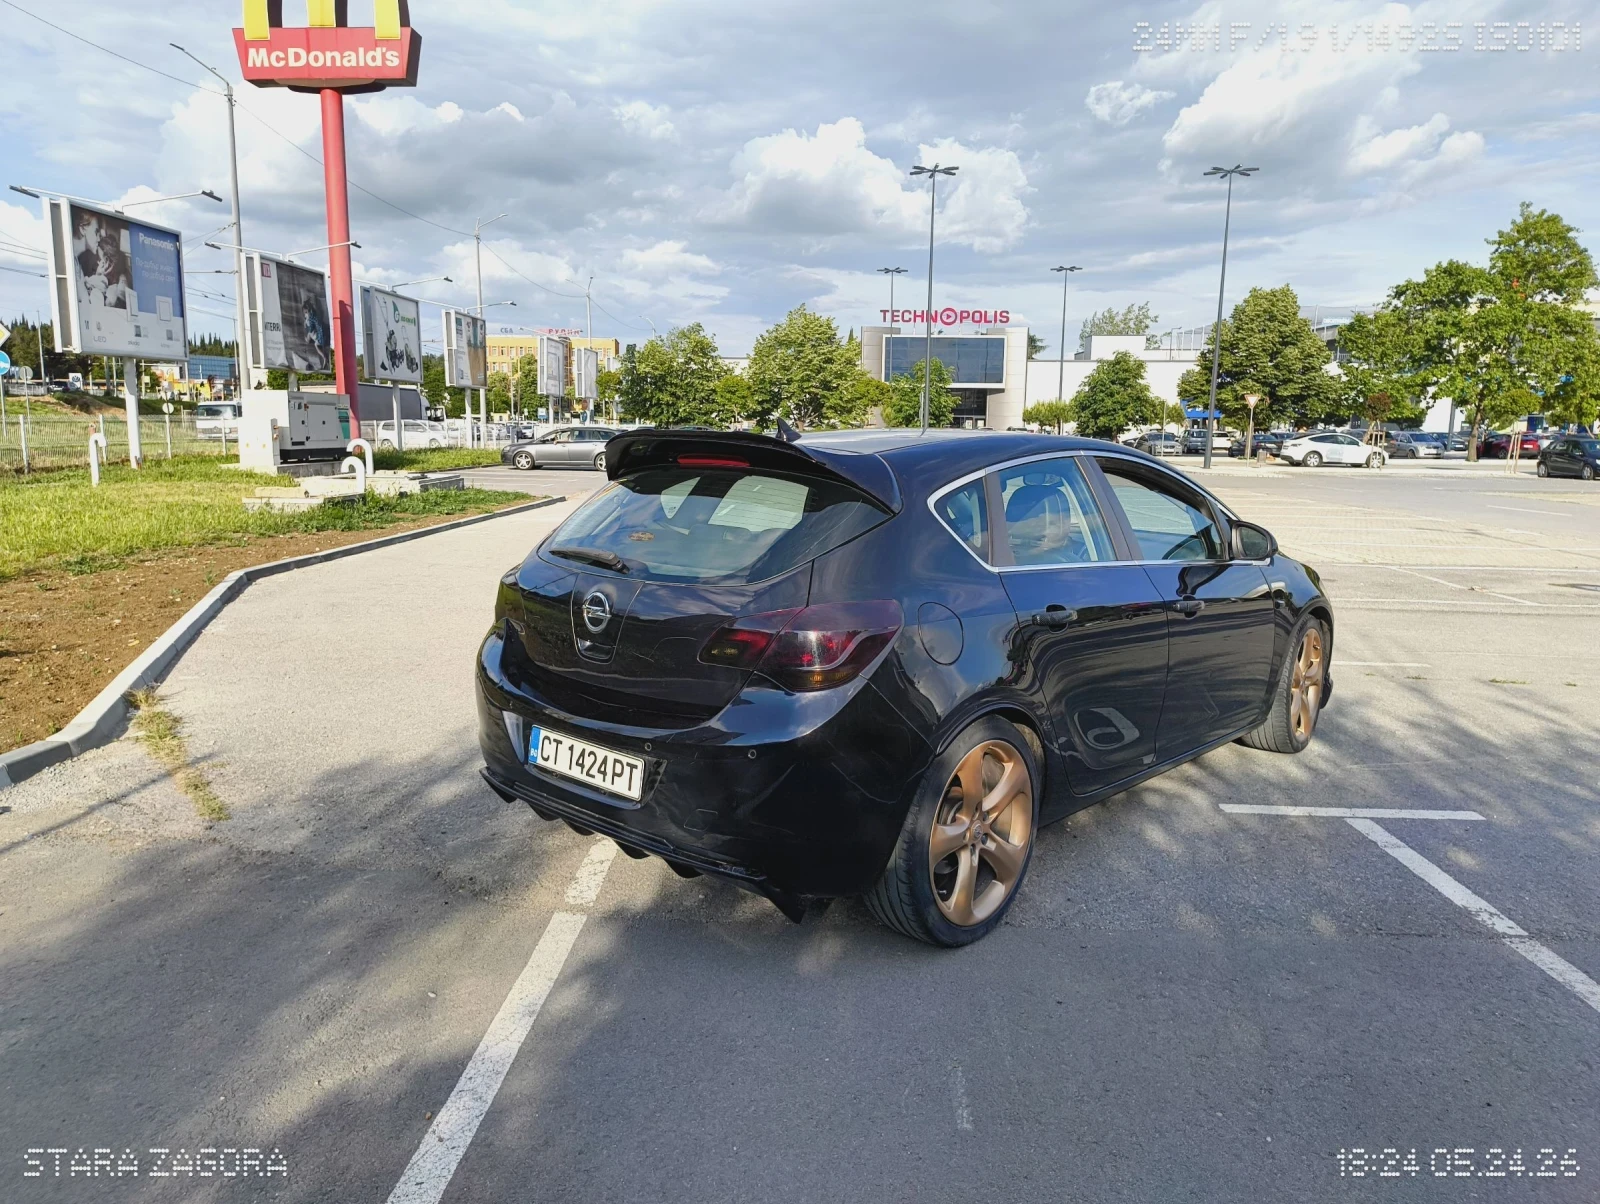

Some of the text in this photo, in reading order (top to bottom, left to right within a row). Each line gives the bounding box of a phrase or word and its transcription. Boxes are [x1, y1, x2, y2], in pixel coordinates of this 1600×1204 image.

[247, 47, 400, 67] McDonald's
[139, 232, 174, 251] Panasonic
[880, 307, 1010, 325] TECHNOPOLIS
